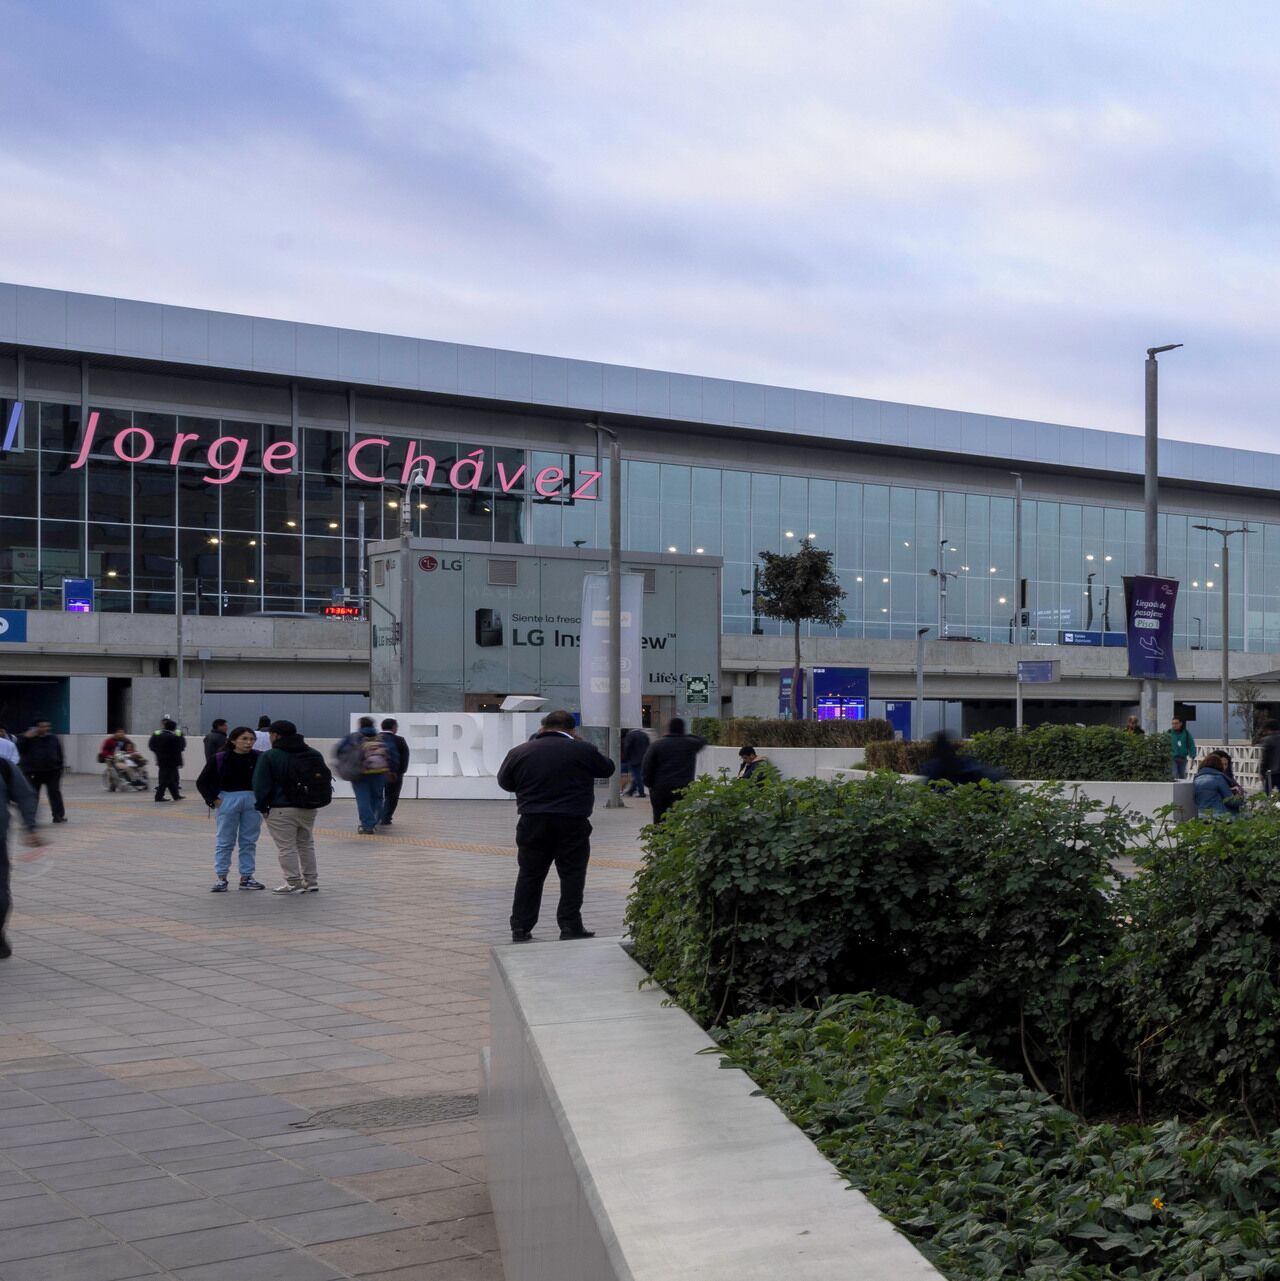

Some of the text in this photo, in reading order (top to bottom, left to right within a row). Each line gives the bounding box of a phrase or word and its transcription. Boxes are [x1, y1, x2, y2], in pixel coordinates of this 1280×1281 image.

[70, 411, 297, 484] Jorge
[347, 438, 603, 500] Chávez
[442, 560, 462, 571] LG
[512, 614, 543, 623] Siente
[545, 615, 555, 623] la
[556, 616, 582, 624] fresc
[512, 629, 545, 646] LG
[351, 695, 549, 777] ERÚ
